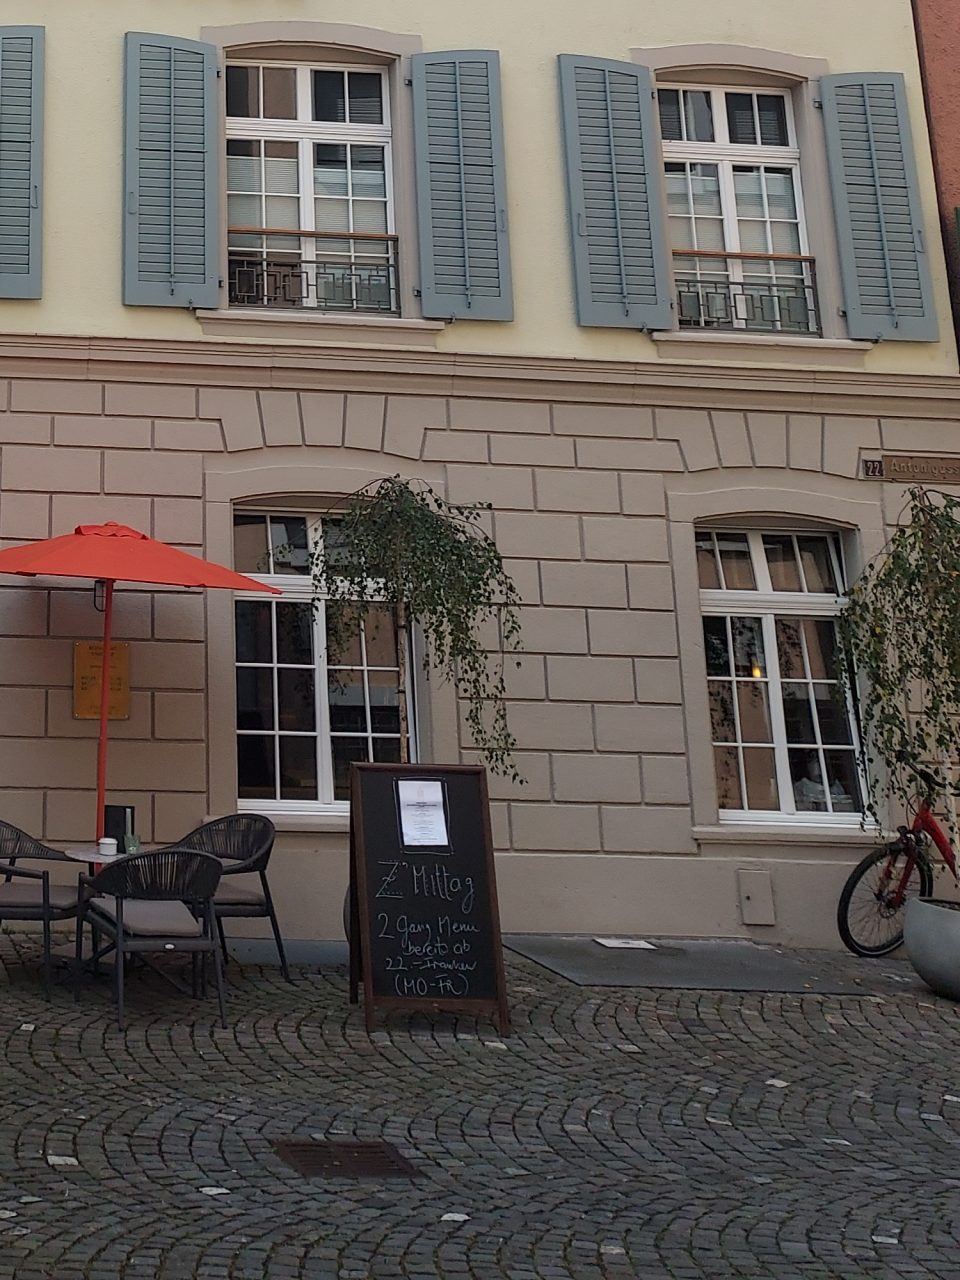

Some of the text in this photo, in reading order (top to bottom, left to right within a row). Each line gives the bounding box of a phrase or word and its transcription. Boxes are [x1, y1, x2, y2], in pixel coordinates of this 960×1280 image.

[867, 461, 881, 476] 22
[890, 459, 960, 477] Antonigass
[378, 912, 395, 939] 2
[453, 938, 471, 955] ab
